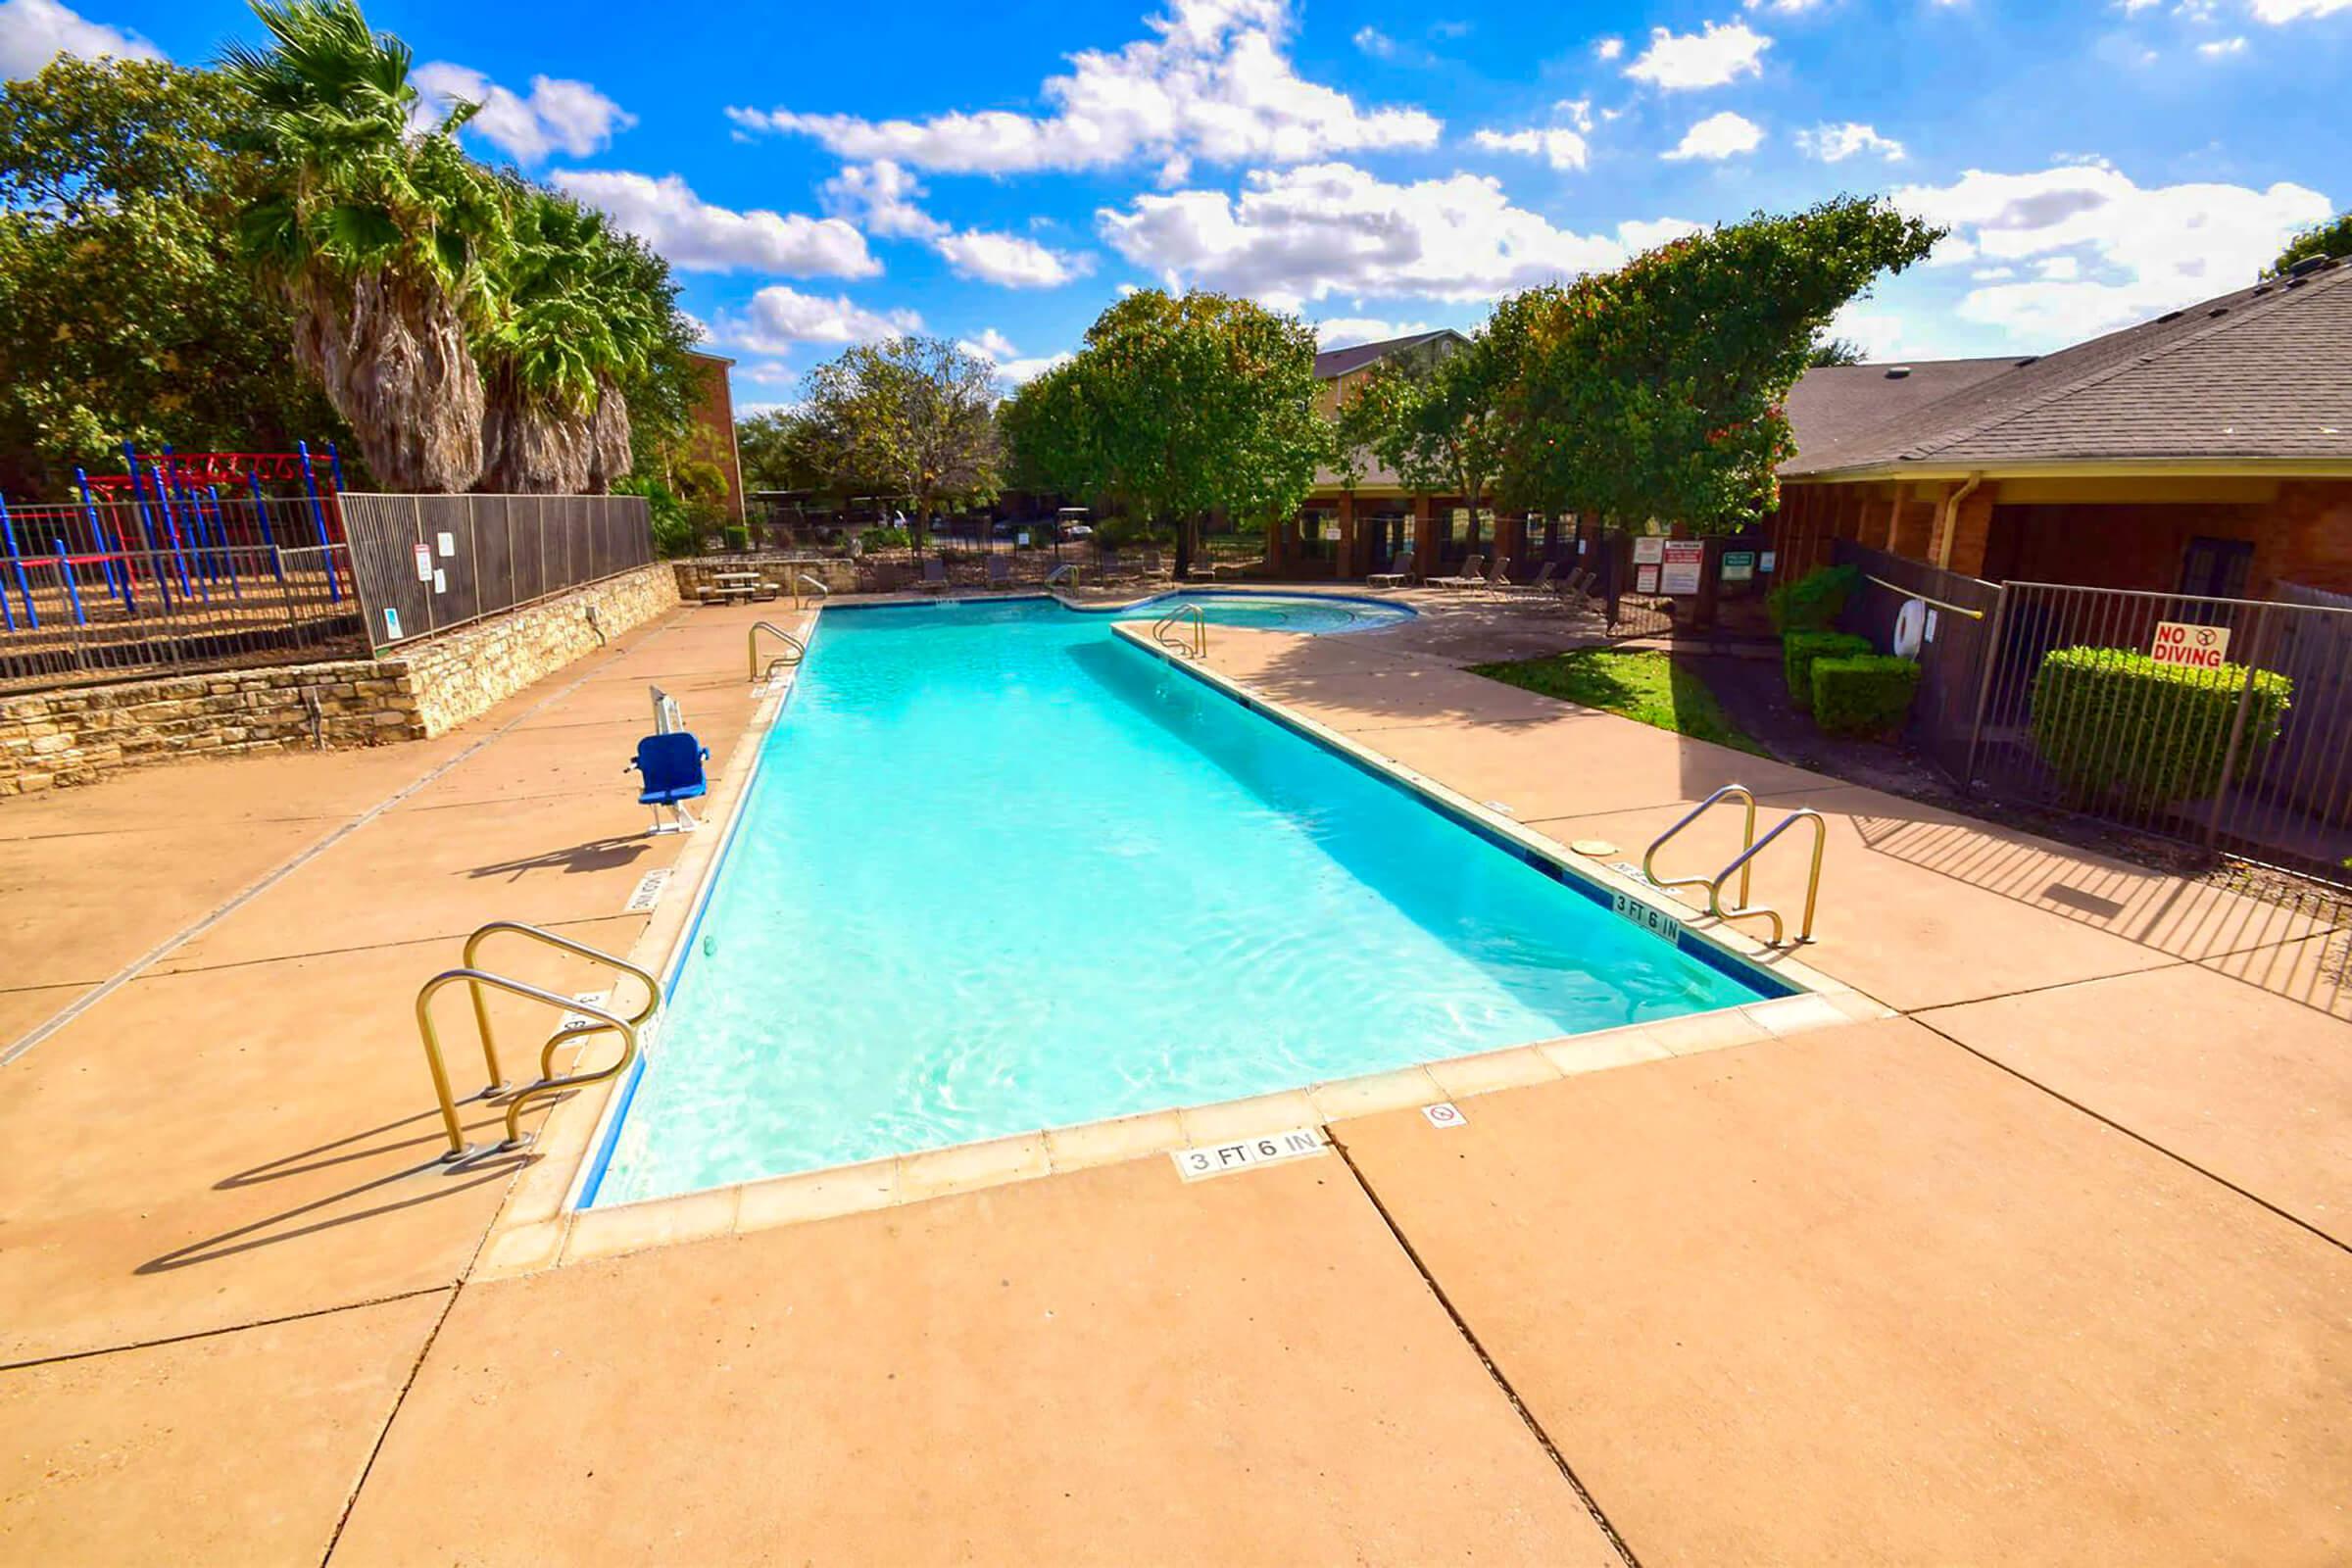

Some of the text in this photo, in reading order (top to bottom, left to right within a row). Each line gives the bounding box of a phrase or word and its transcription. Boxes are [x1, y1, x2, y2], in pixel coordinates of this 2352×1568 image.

[2158, 626, 2185, 644] NO
[2153, 644, 2222, 667] DIVING
[1617, 896, 1678, 939] 3 FT 6 IN
[1190, 1133, 1317, 1170] 3 FT 6 IN
